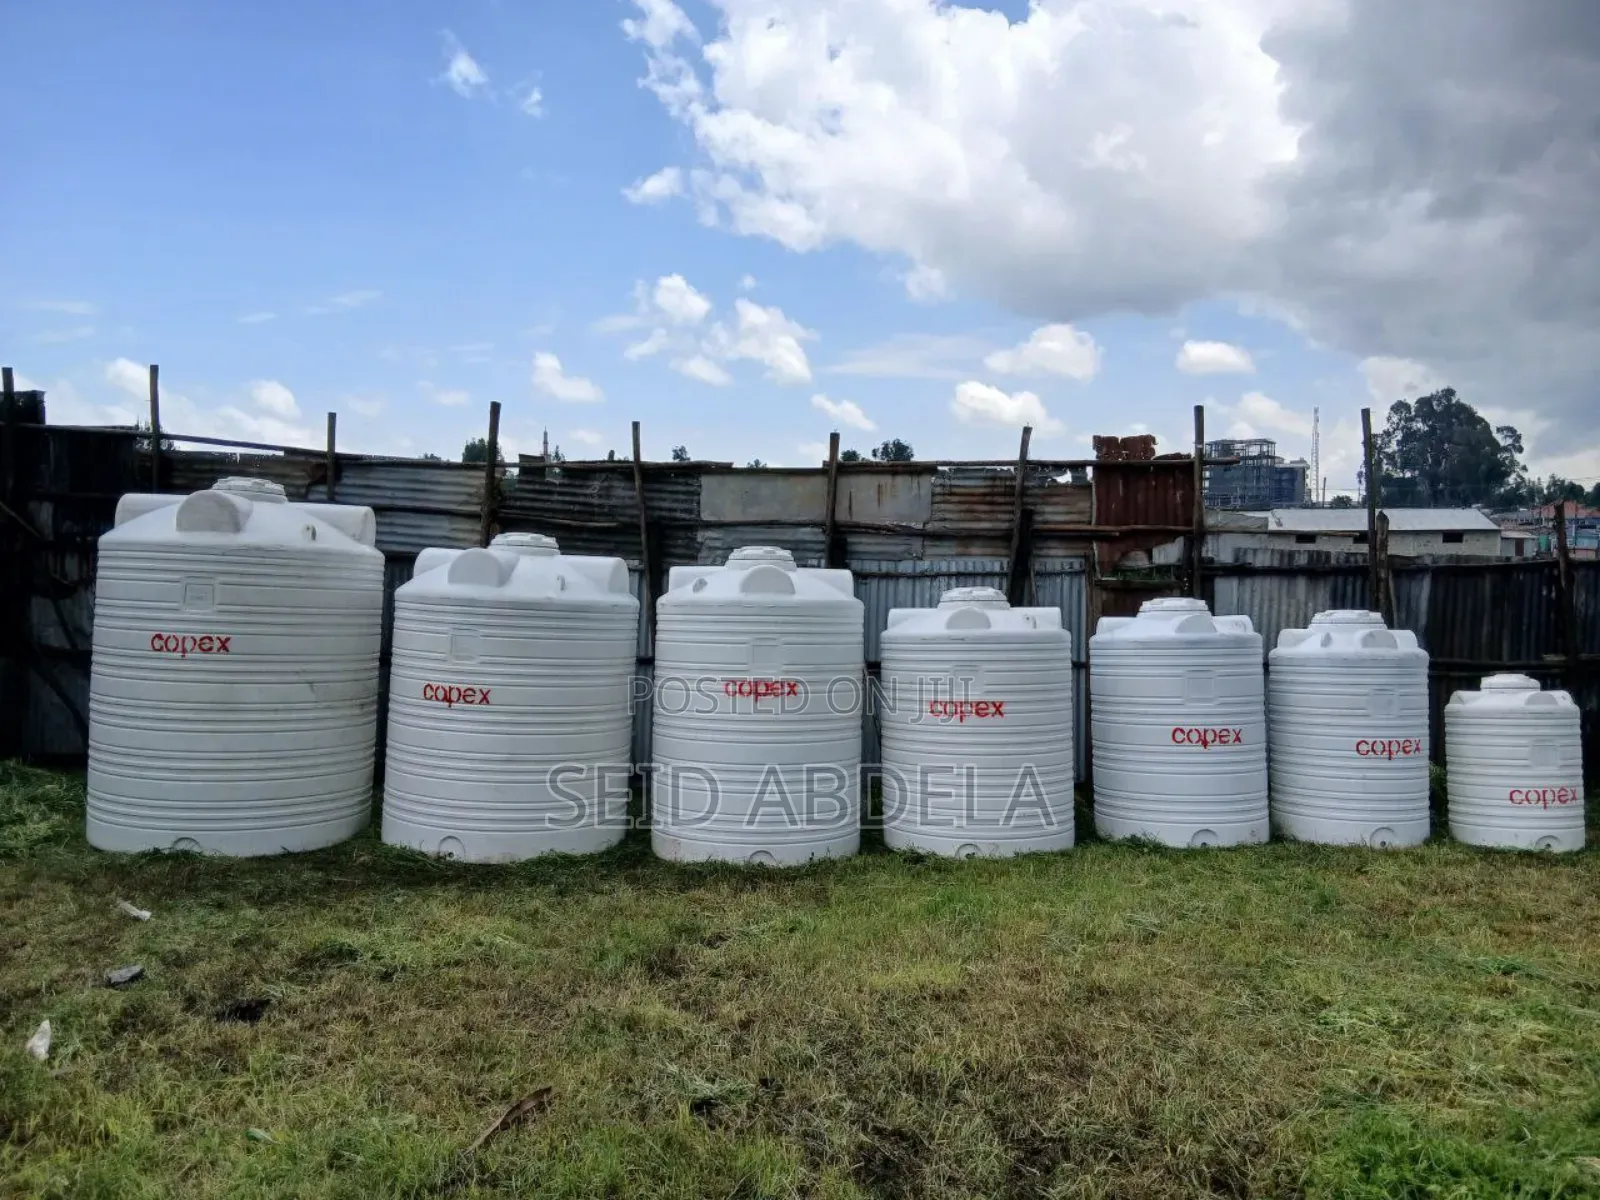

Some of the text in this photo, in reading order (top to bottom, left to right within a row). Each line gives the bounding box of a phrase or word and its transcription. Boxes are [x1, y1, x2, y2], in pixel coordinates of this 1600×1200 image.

[150, 633, 231, 657] copex
[423, 683, 492, 708] copex
[723, 680, 799, 703] copex
[929, 700, 1005, 722] copex
[1171, 727, 1242, 749] copex
[1355, 739, 1421, 760] copex
[1509, 786, 1577, 810] copex
